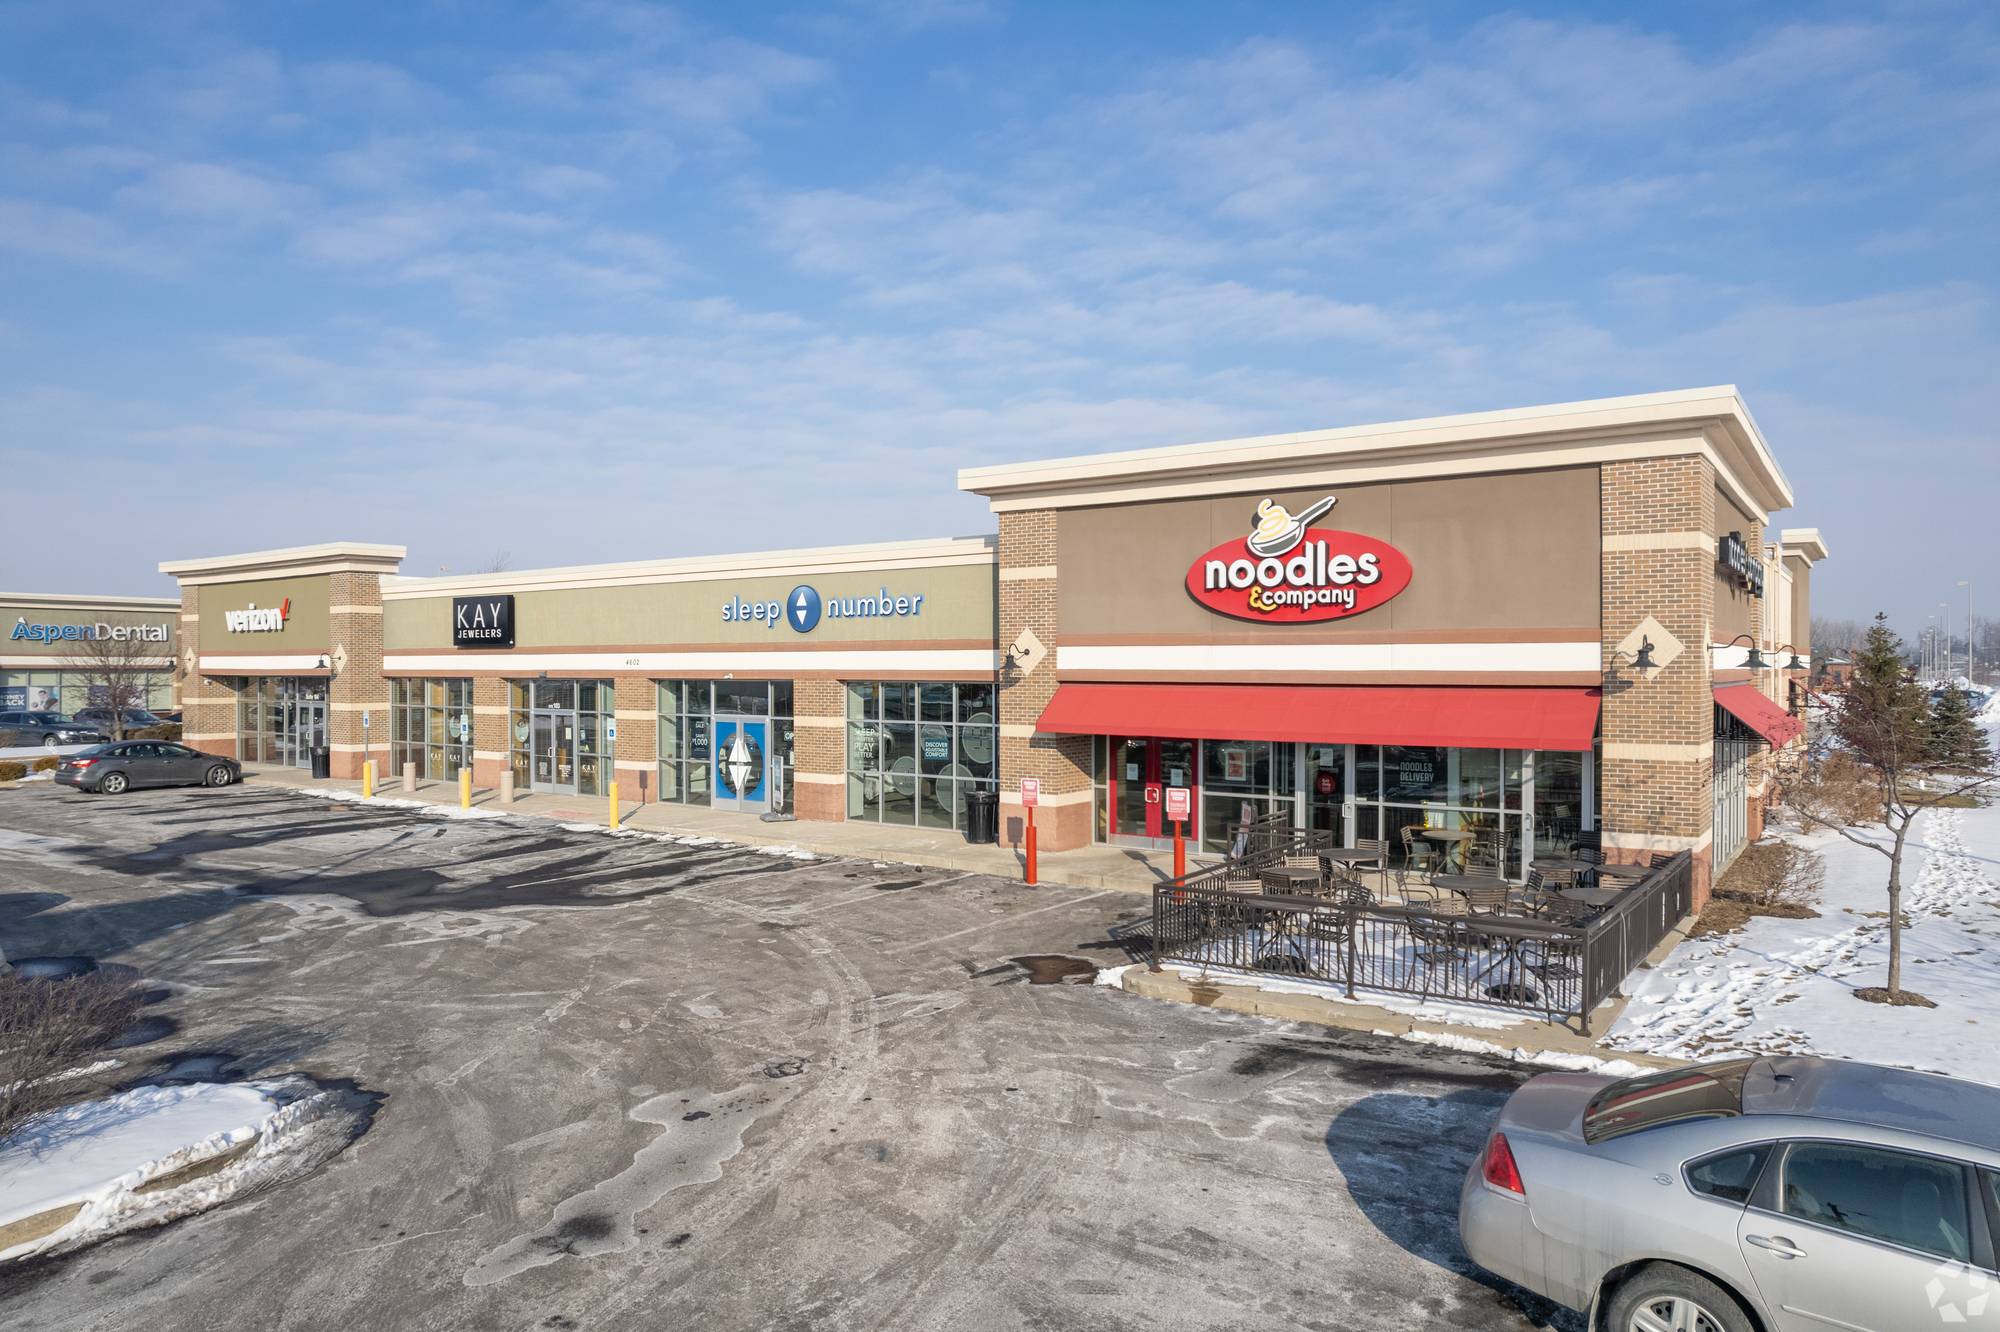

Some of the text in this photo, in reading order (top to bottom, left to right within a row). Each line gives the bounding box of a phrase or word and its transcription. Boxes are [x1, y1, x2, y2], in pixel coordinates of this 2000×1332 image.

[1205, 540, 1379, 589] noodles
[225, 603, 283, 632] verizon
[457, 603, 501, 629] KAY
[722, 588, 922, 627] sleep number
[457, 629, 502, 639] JEWELERS
[854, 743, 874, 752] PLAY
[1400, 771, 1435, 782] DELIVERY
